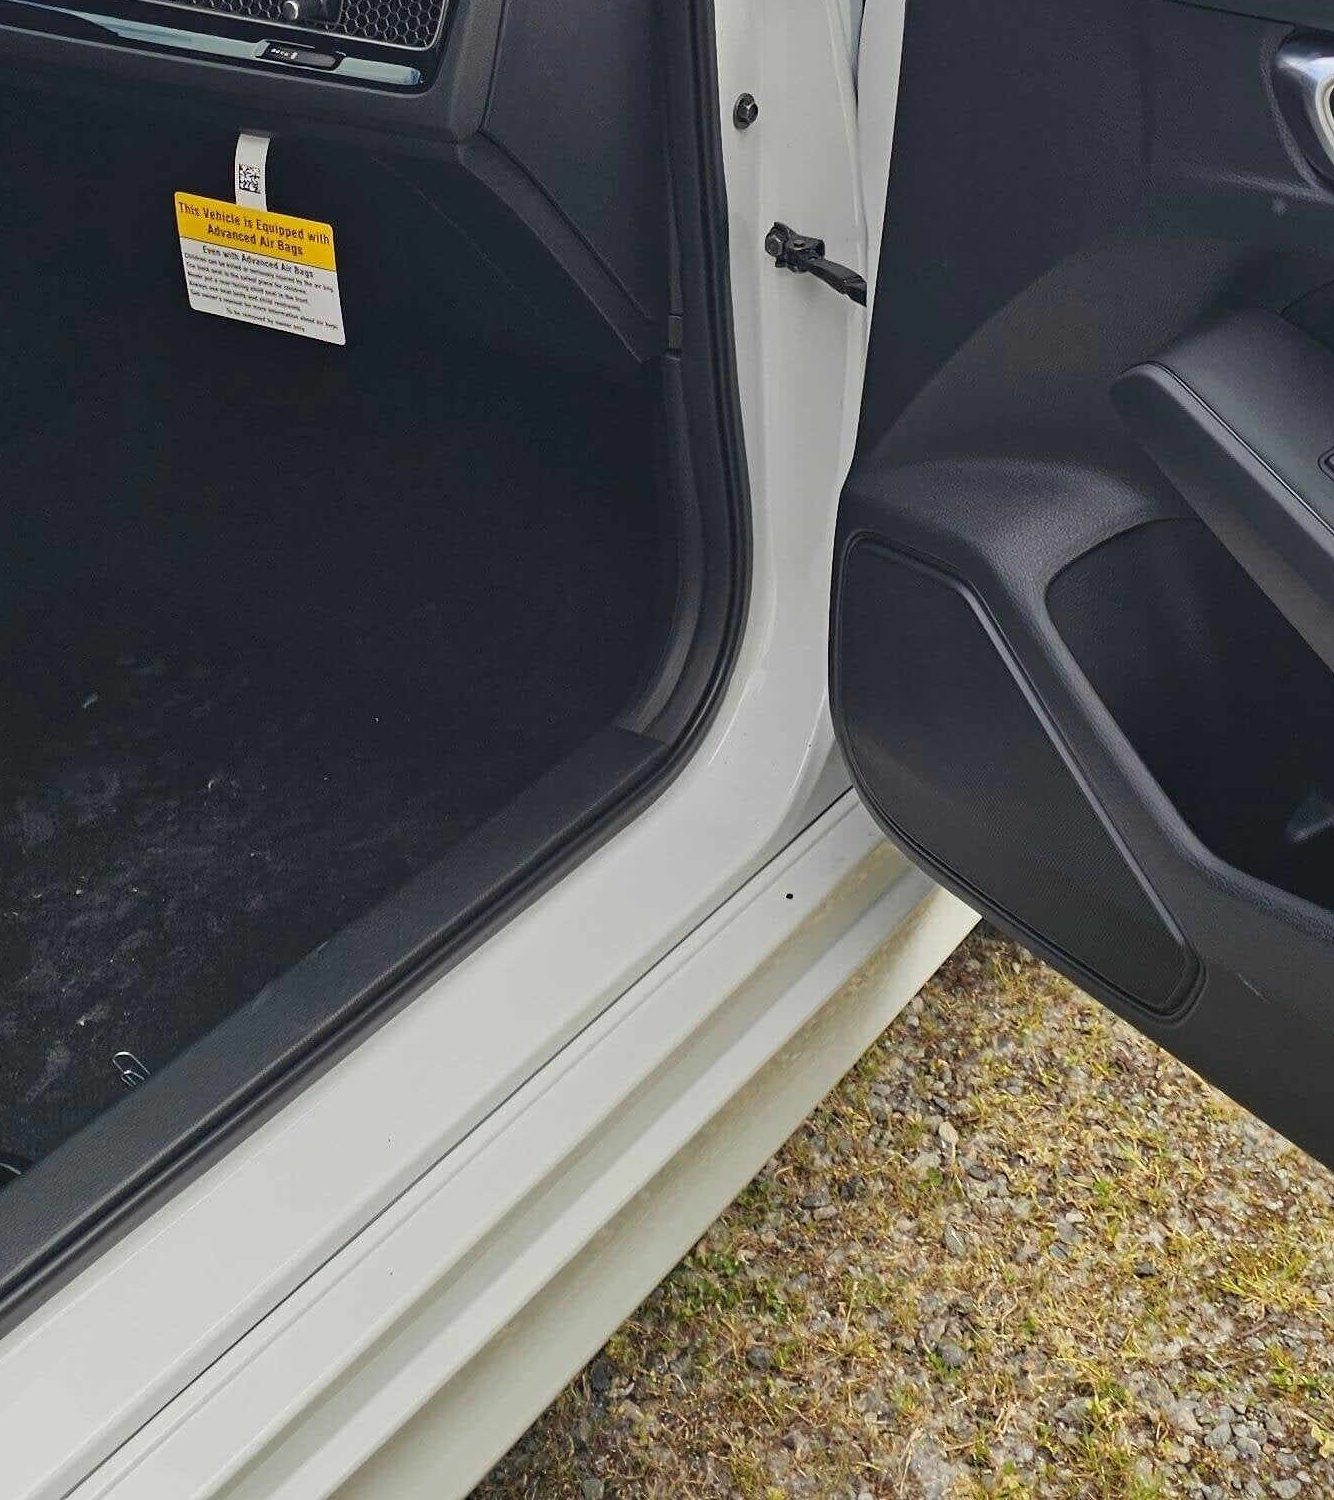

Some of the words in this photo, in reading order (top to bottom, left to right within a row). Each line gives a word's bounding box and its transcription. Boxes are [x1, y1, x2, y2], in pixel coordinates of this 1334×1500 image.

[178, 202, 200, 217] This
[203, 207, 240, 225] Vehicle
[244, 216, 253, 229] is
[256, 219, 304, 240] Equipped
[308, 232, 330, 245] with
[208, 224, 257, 245] Advanced
[260, 236, 274, 249] Air
[278, 240, 304, 256] Bags
[203, 245, 220, 256] Even
[223, 251, 239, 260] with
[241, 254, 279, 270] Advanced
[281, 263, 292, 273] Air
[294, 266, 314, 278] Bags
